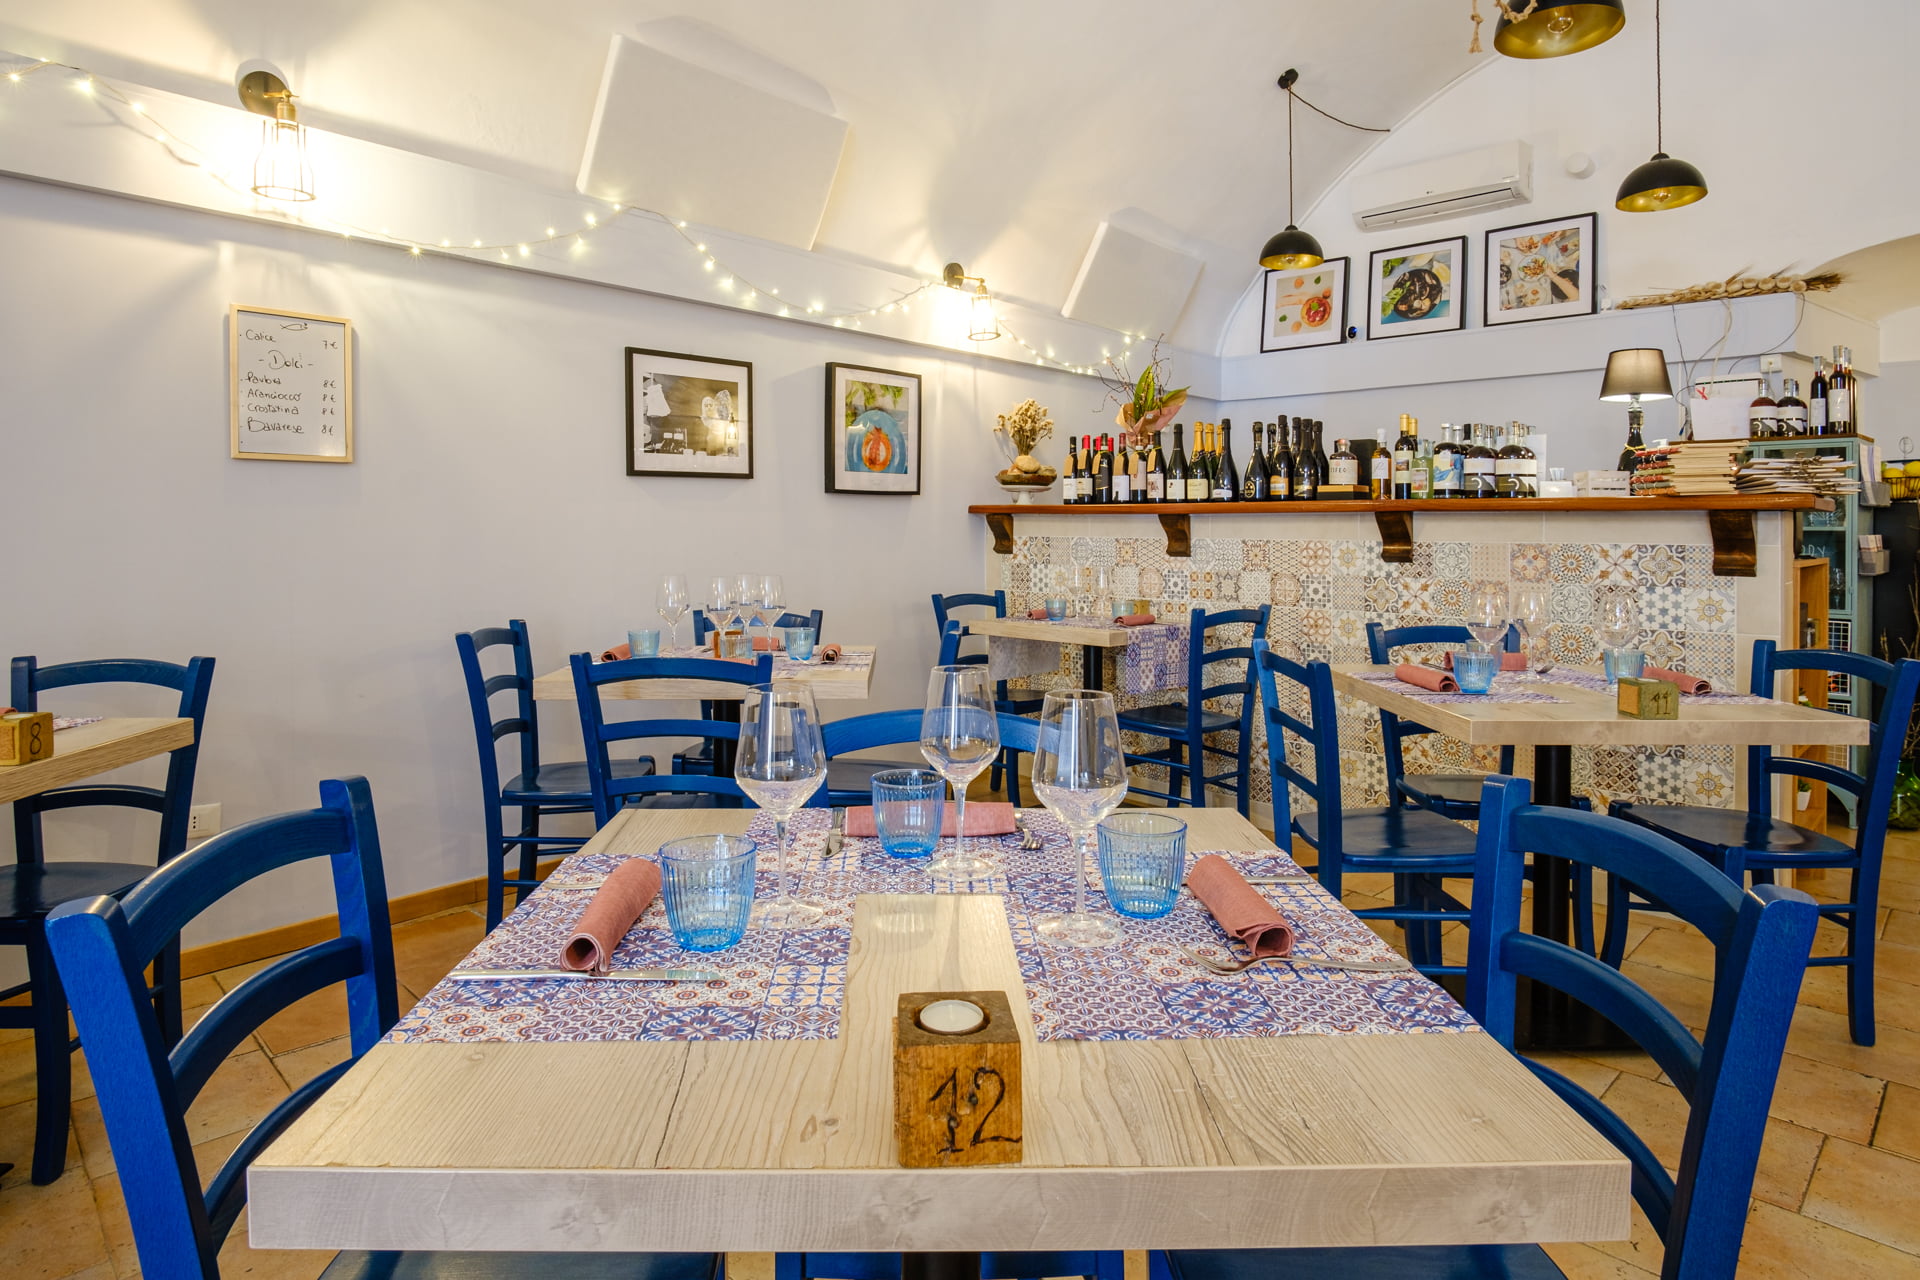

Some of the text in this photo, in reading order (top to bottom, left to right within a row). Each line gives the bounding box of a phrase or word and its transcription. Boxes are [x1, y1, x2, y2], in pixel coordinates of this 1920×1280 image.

[247, 416, 304, 434] Bavarese
[30, 722, 42, 755] 8
[929, 1067, 1022, 1154] 12
